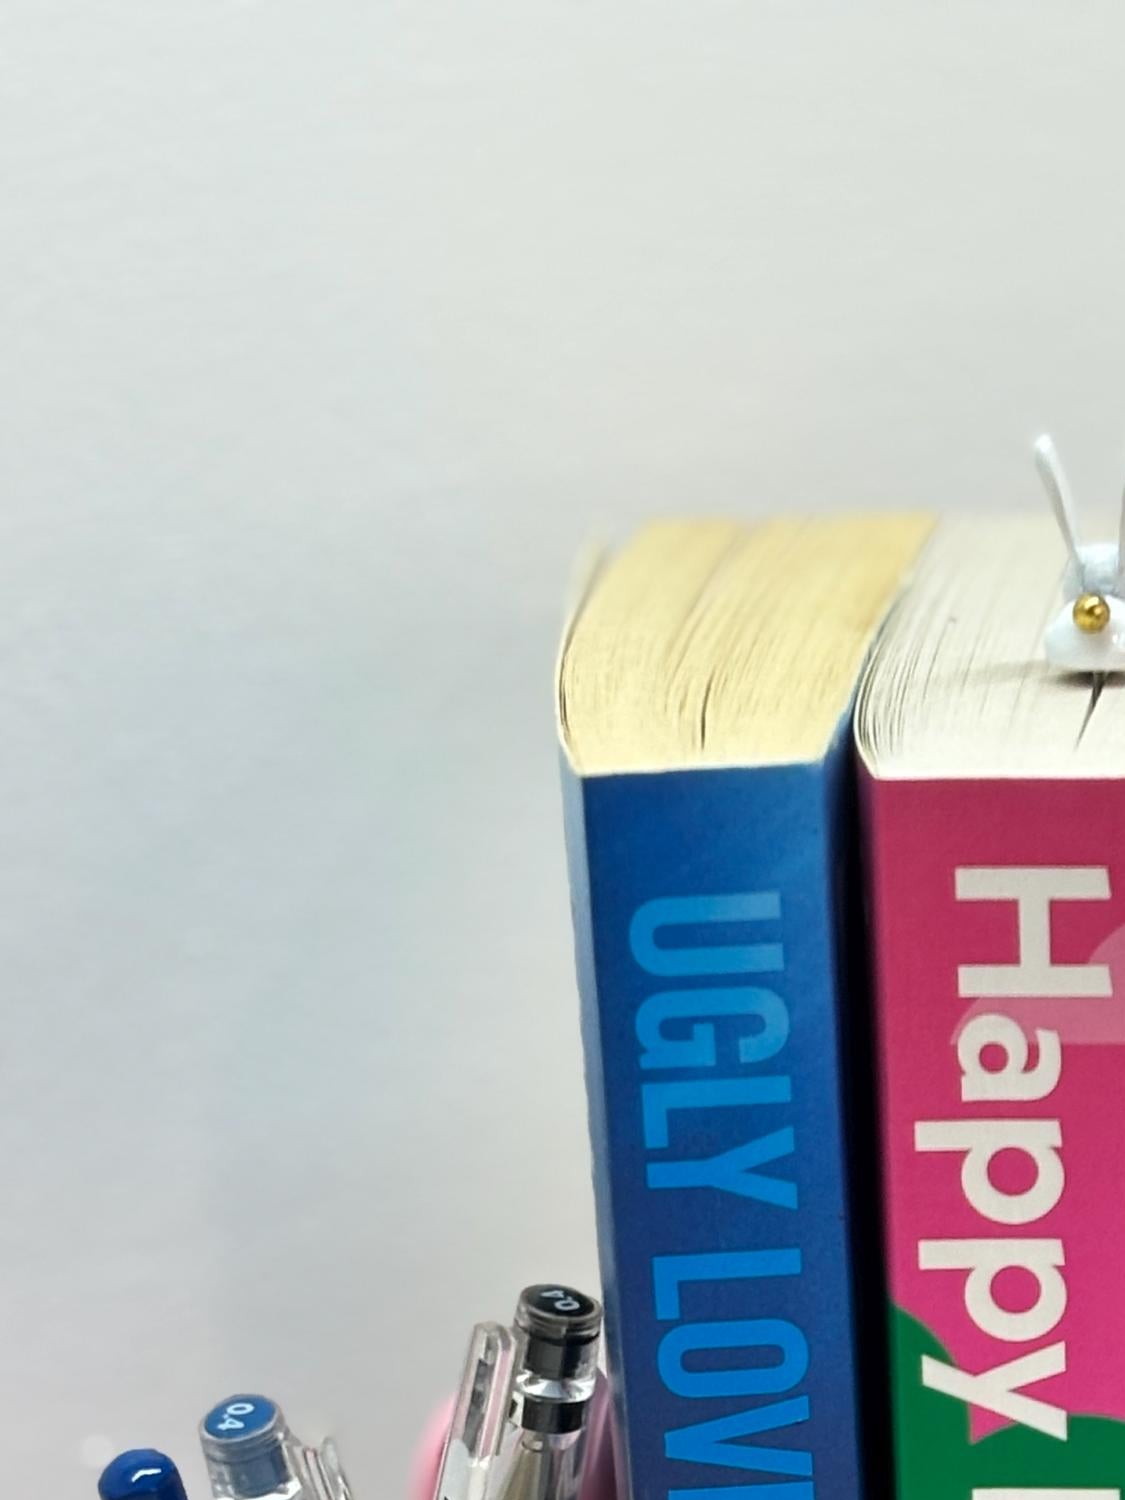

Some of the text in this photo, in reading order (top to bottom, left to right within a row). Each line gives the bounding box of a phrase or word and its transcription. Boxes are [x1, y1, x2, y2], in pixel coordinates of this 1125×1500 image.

[628, 890, 798, 1210] UGLY
[914, 865, 1113, 1442] Happy
[540, 1289, 581, 1311] 0.4
[217, 1402, 255, 1431] 0.4
